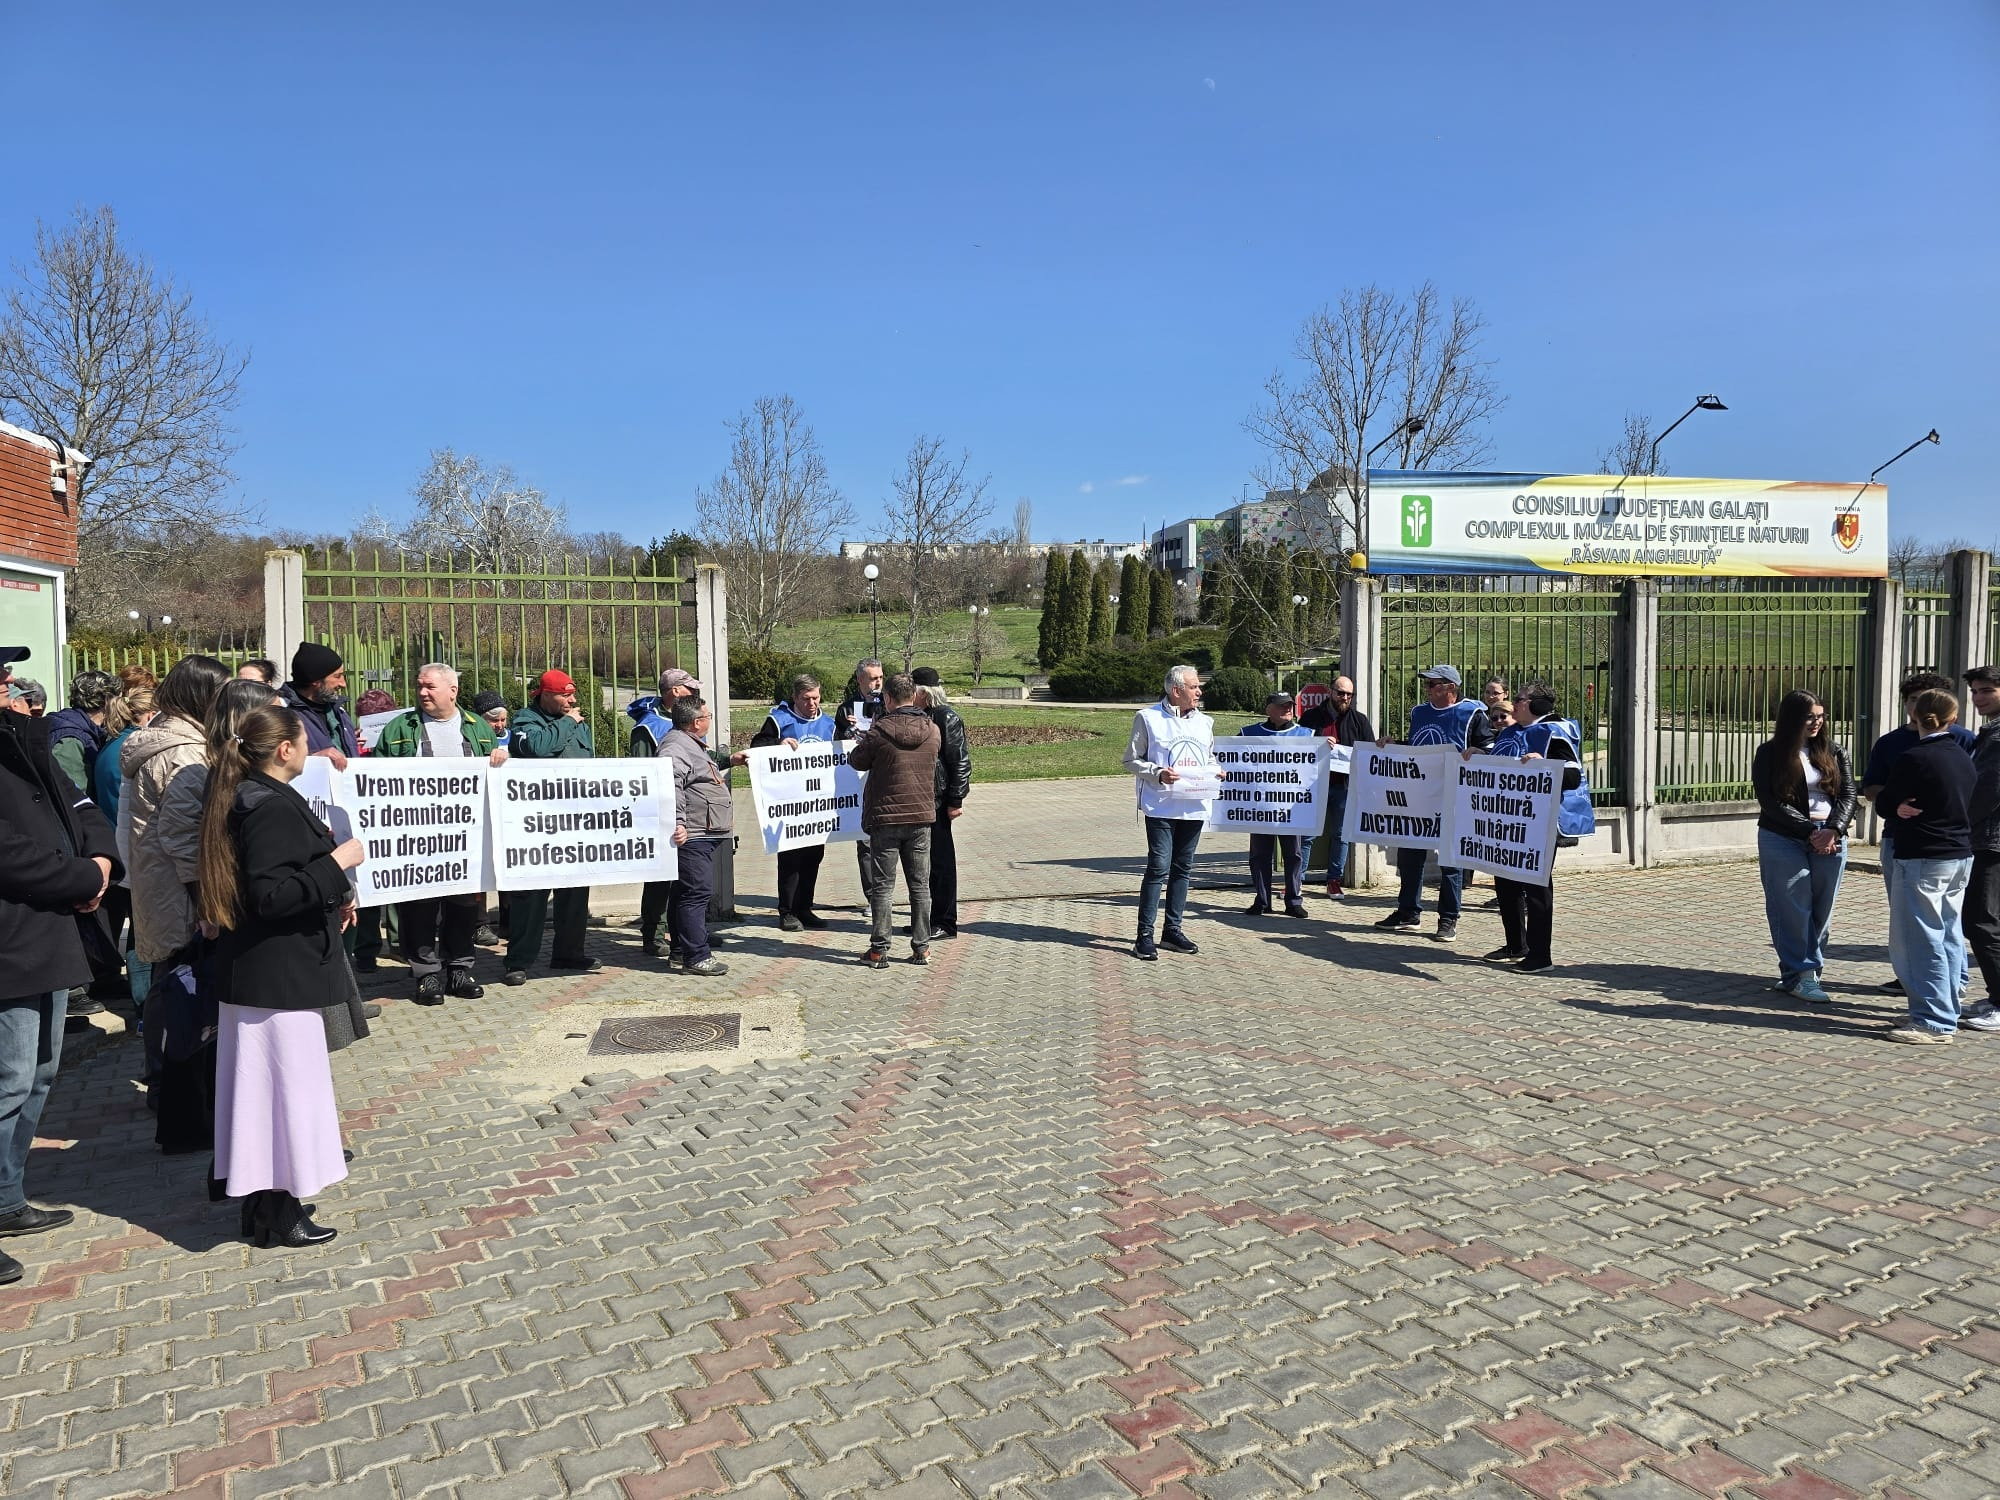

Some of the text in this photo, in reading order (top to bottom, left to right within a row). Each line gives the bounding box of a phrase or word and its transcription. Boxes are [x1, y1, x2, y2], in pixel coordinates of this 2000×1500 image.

[1512, 495, 1610, 516] CONSILIUL
[1709, 500, 1769, 525] GALAȚI
[1465, 520, 1810, 546] COMPLEXUL MUZEAL DE ȘTIINȚELE NATURII
[768, 757, 803, 774] Vrem
[1241, 750, 1316, 764] conducere
[1369, 755, 1426, 781] Cultură,
[355, 774, 479, 798] Vrem respect
[506, 776, 649, 803] Stabilitate și
[805, 778, 821, 792] nu
[1220, 769, 1302, 785] ompetentă,
[1458, 766, 1496, 789] Pentru
[1498, 771, 1553, 794] școală
[768, 793, 859, 819] comportament
[1217, 788, 1313, 804] entru o muncă
[1386, 789, 1408, 807] nu
[1481, 794, 1537, 820] cultură,
[358, 803, 476, 833] și demnitate,
[523, 806, 633, 834] siguranță
[785, 816, 841, 840] incorect!
[1227, 807, 1292, 824] eficientă!
[1359, 811, 1442, 839] DICTATURĂ
[1474, 818, 1527, 844] nu hârtii
[368, 830, 467, 859] nu drepturi
[506, 836, 655, 869] profesională!
[1460, 836, 1541, 872] fără măsură!
[372, 858, 468, 890] confiscate!
